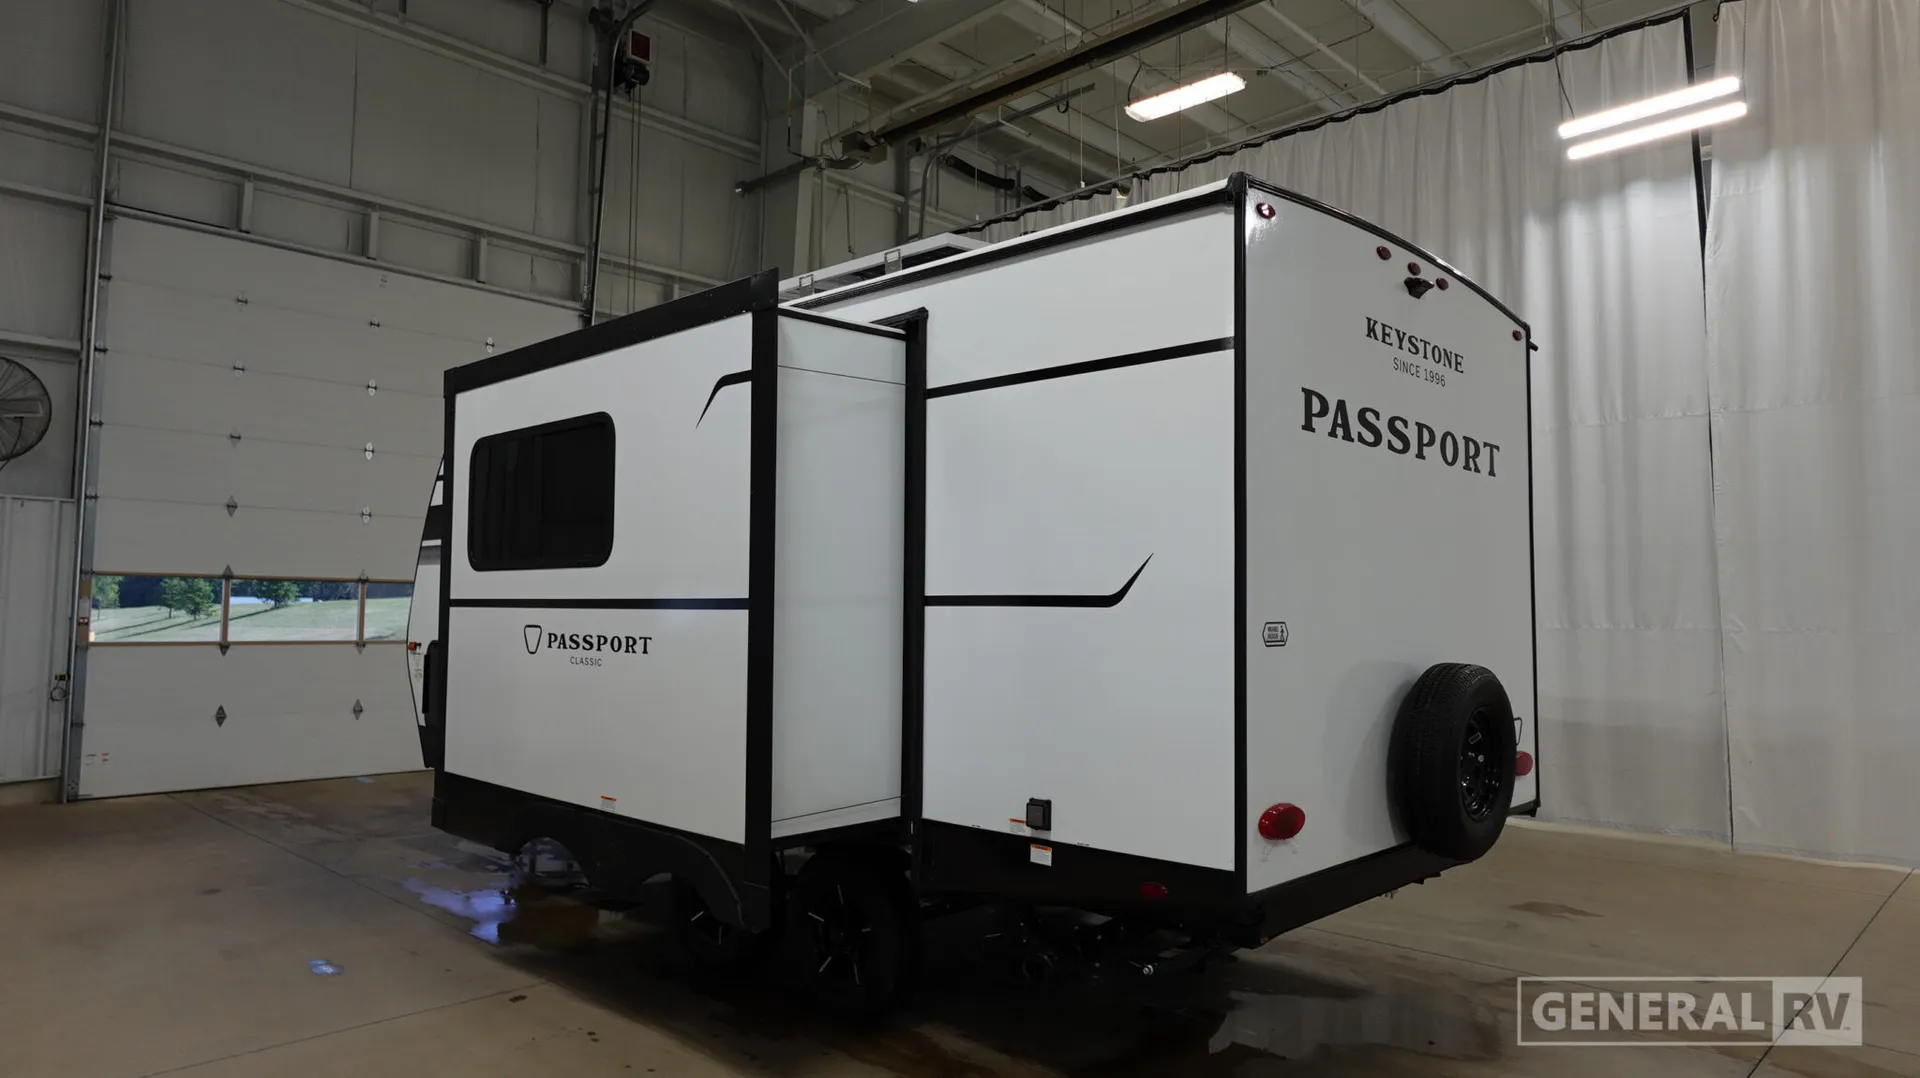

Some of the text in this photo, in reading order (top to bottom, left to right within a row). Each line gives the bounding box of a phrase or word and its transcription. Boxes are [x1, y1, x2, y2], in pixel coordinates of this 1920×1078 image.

[1365, 316, 1464, 374] KEYSTONE
[1393, 357, 1446, 387] SINCE 1996
[1301, 386, 1500, 477] PASSPORT
[547, 632, 653, 654] PASSPORT
[570, 656, 602, 666] CLASSIC
